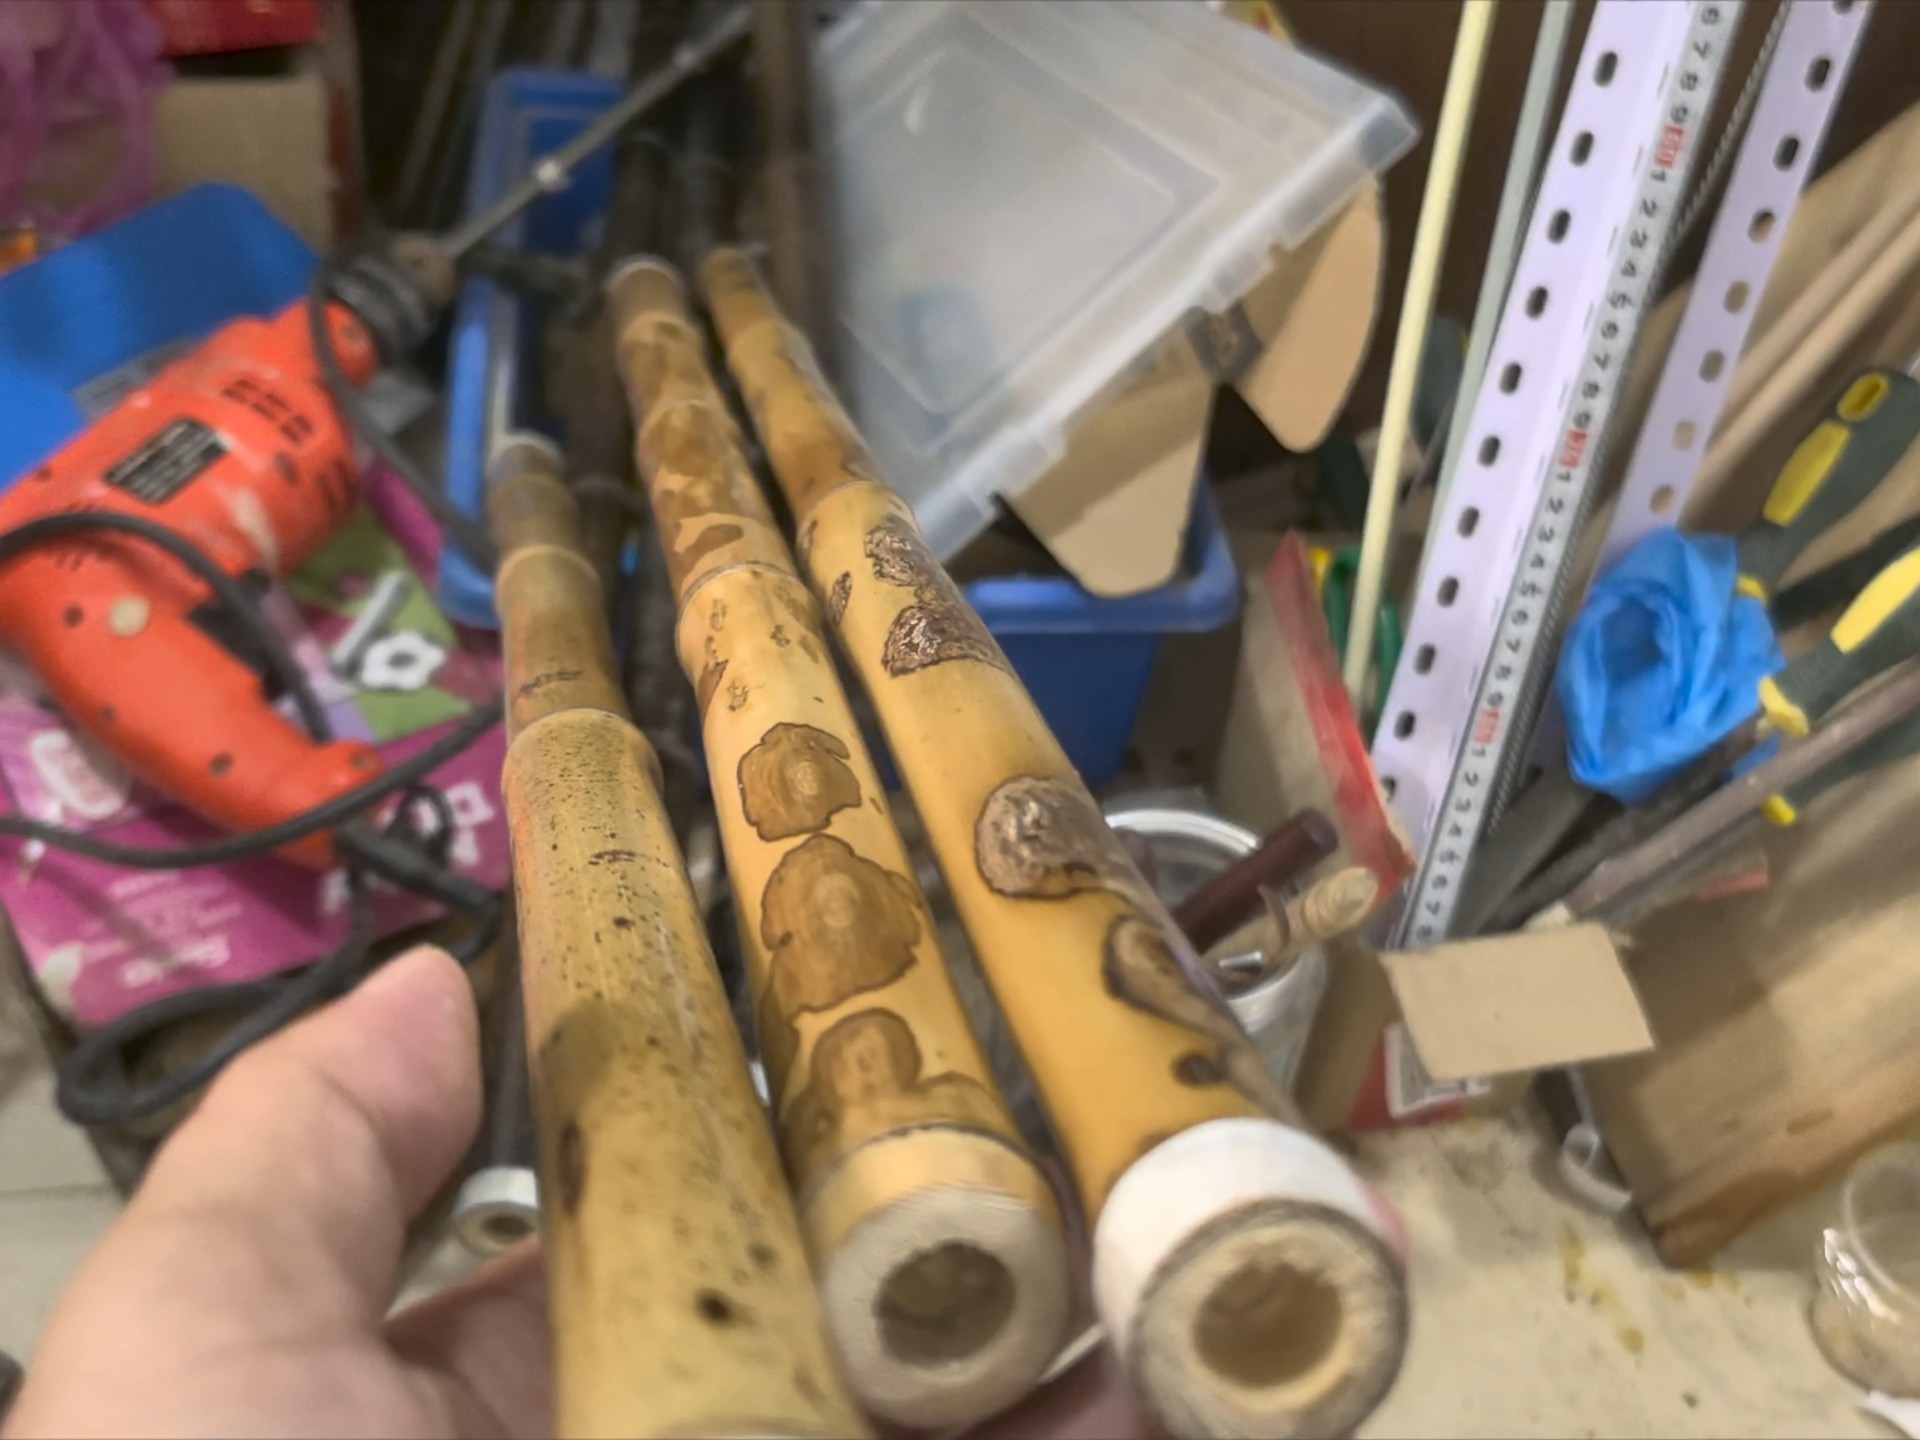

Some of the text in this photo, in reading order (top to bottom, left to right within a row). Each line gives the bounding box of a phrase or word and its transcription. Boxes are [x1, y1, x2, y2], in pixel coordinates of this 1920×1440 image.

[1693, 40, 1708, 59] 7
[1593, 352, 1611, 371] 7
[1505, 637, 1522, 654] 7
[1425, 901, 1441, 917] 7
